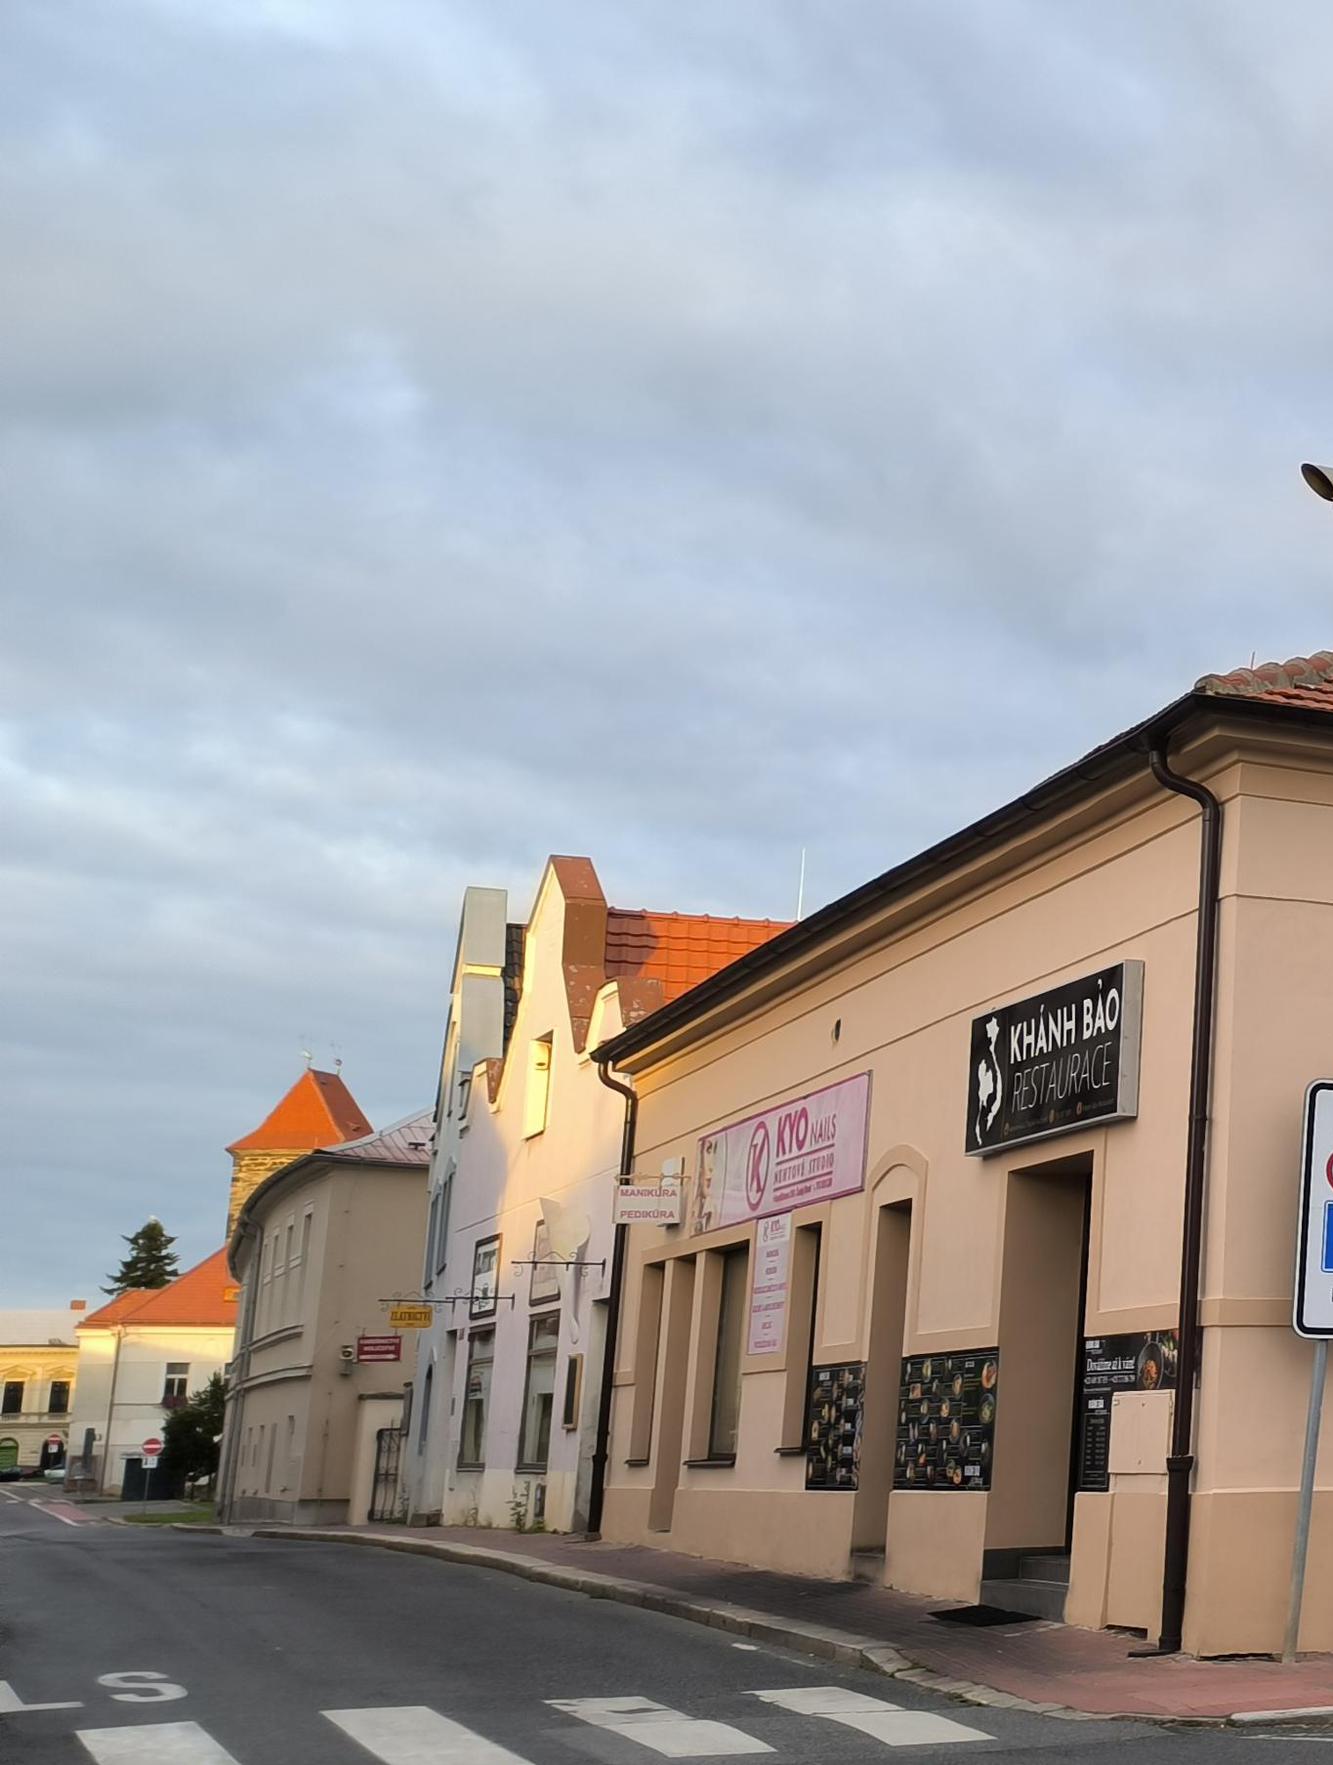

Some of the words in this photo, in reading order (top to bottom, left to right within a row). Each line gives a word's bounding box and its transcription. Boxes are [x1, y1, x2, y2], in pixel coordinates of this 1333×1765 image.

[1009, 1003, 1077, 1065] KHÁNH
[1082, 978, 1121, 1041] BẢO
[1011, 1041, 1113, 1114] RESTAURACE
[775, 1106, 810, 1159] KYO
[809, 1113, 838, 1147] NAILS
[808, 1152, 835, 1174] STUDIO
